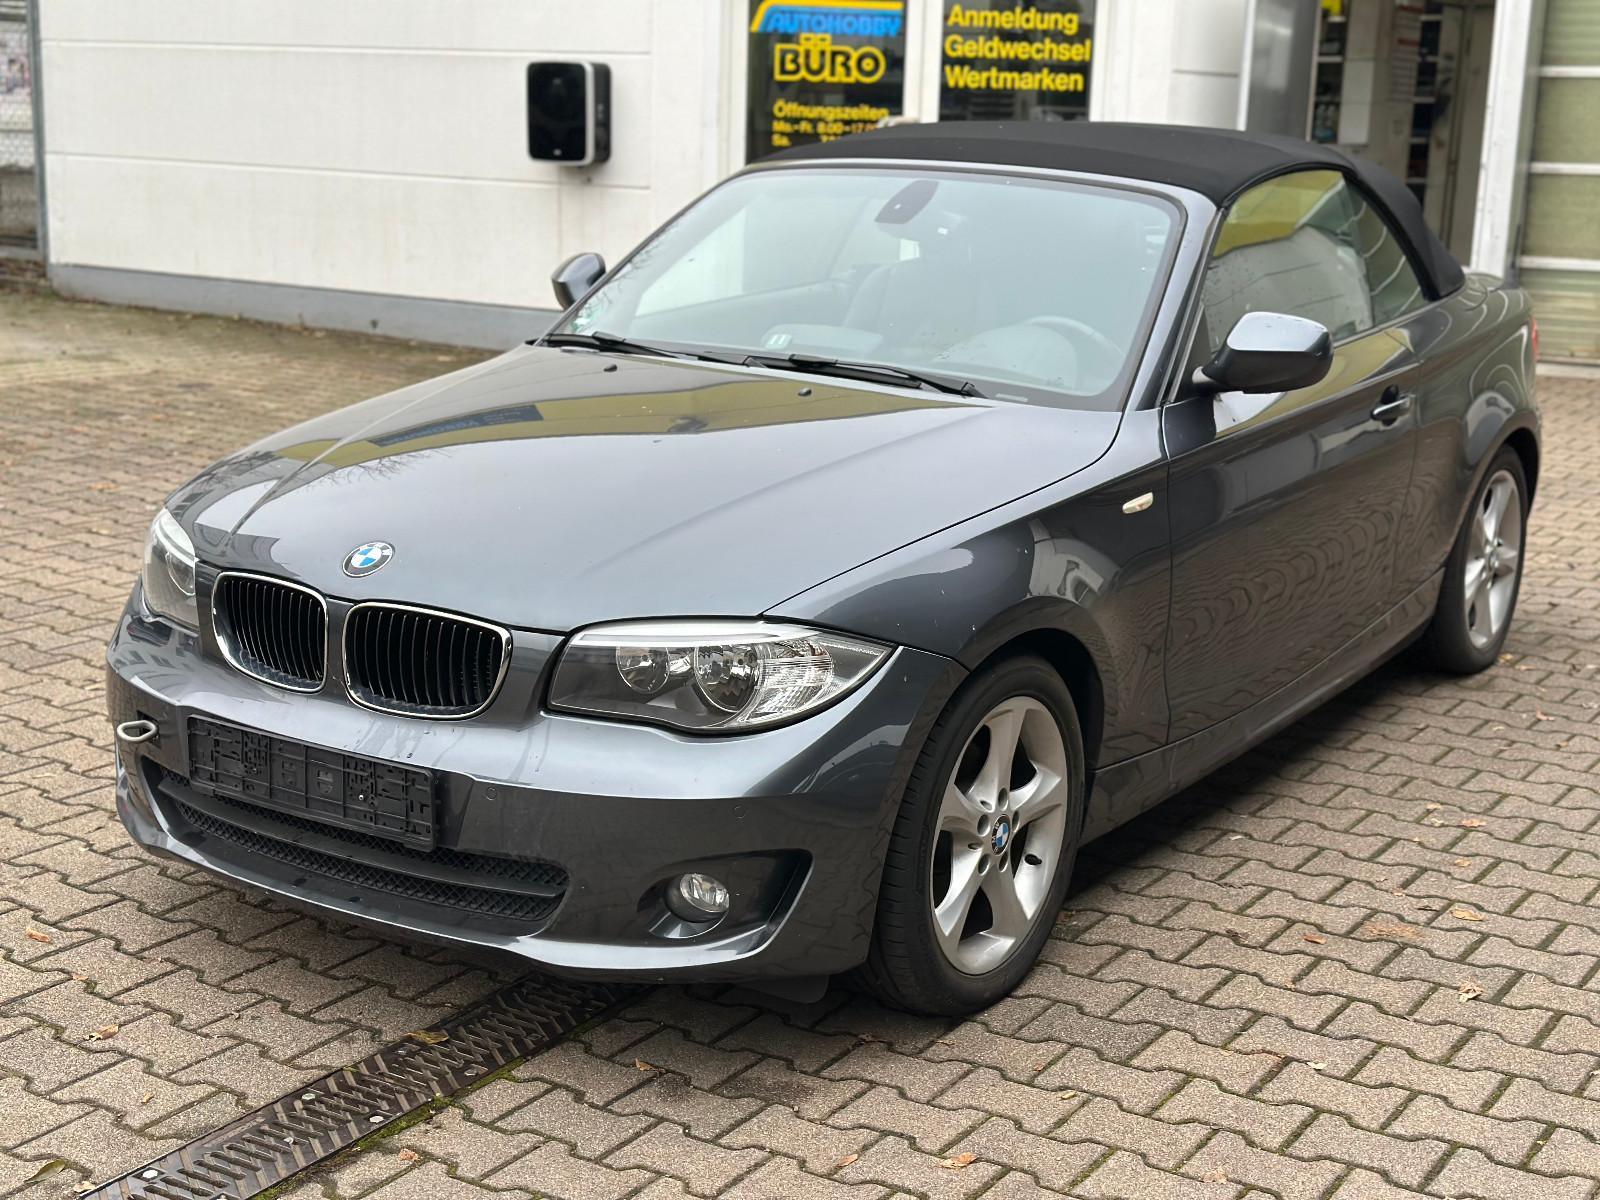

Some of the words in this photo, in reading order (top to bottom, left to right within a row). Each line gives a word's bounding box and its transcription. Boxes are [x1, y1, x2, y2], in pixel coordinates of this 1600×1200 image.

[767, 13, 901, 36] AUTOHOBBY
[947, 4, 1080, 35] Anmeldung
[774, 33, 887, 84] BÜRO
[944, 33, 1092, 62] Geldwechsel
[944, 64, 1085, 92] Wertmarken
[772, 98, 890, 122] Öffnungszeiten
